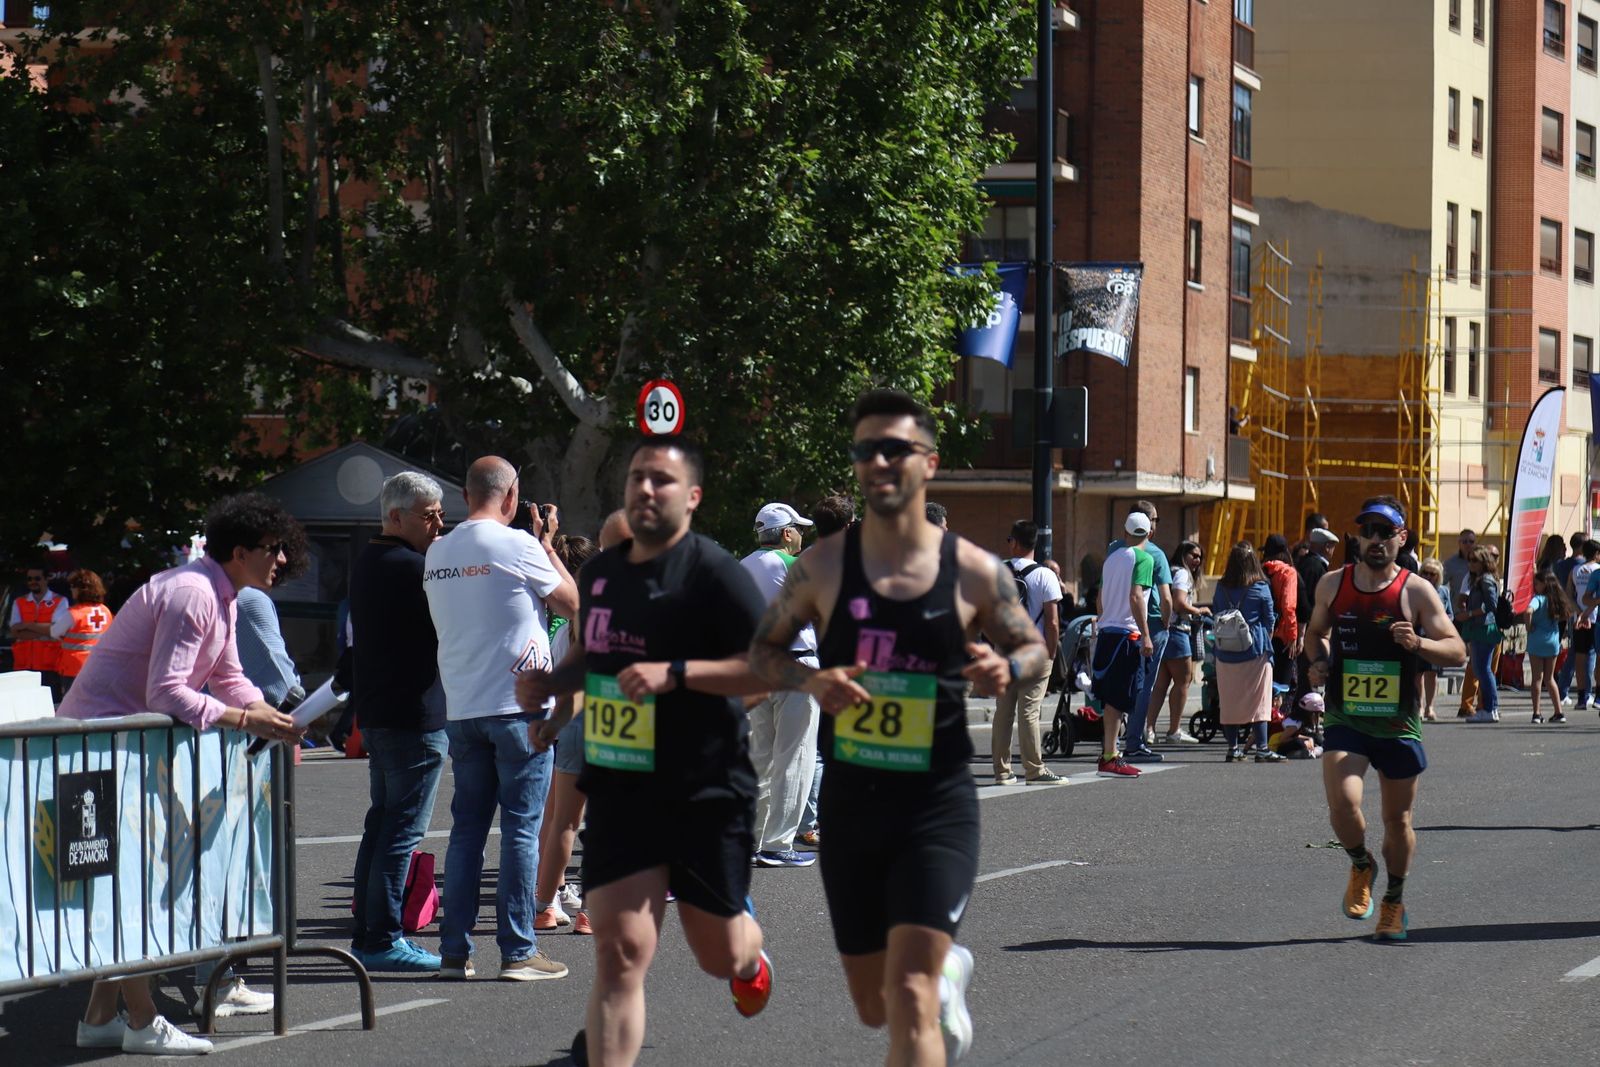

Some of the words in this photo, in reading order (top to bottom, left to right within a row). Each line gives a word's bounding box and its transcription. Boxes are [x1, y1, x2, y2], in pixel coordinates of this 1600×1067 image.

[1108, 272, 1135, 280] vota
[1057, 327, 1127, 358] RESPUESTA
[649, 401, 675, 422] 30
[461, 564, 491, 577] NEWS
[1347, 676, 1388, 699] 212
[588, 702, 638, 740] 192
[853, 701, 902, 737] 28
[69, 839, 109, 852] AYUNTAMIENTO
[69, 851, 79, 866] DE
[79, 848, 109, 863] ZAMORA
